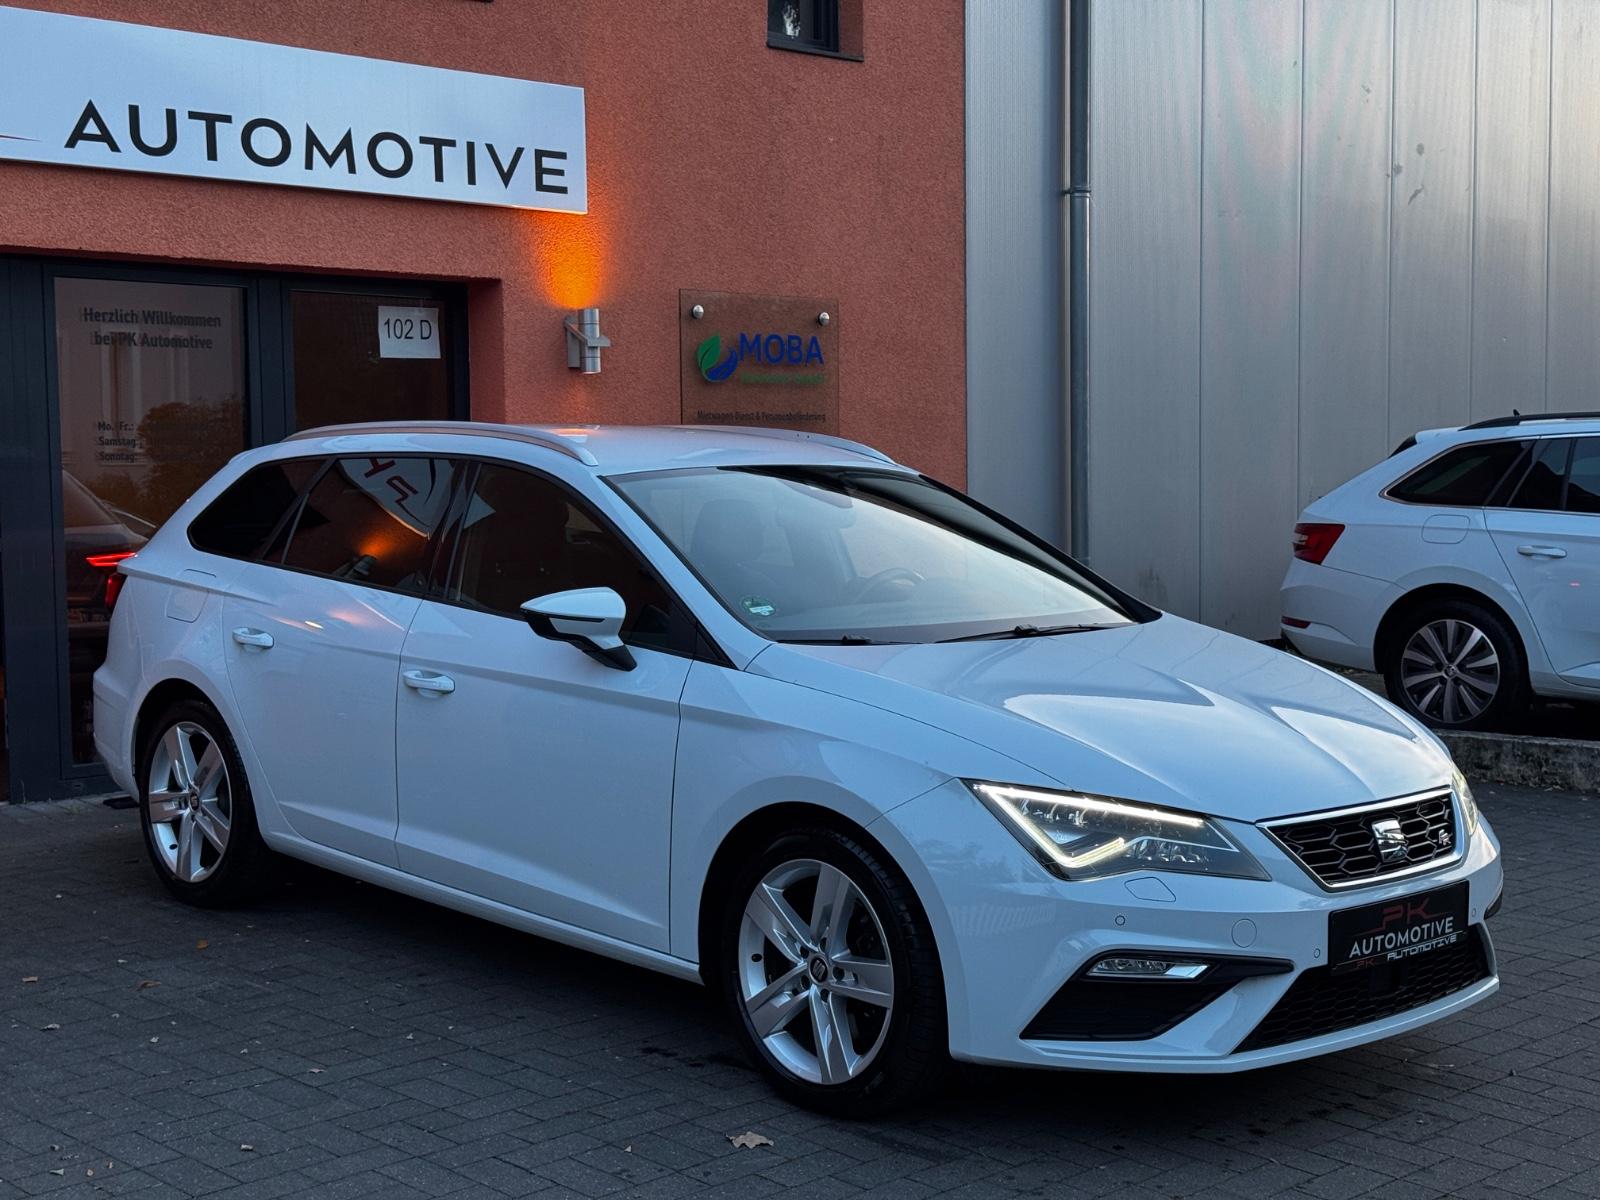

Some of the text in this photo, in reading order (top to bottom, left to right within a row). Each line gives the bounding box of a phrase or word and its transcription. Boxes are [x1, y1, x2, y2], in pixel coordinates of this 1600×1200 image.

[64, 99, 569, 195] AUTOMOTIVE
[83, 308, 221, 327] Herzlich Willkommen
[384, 317, 432, 340] 102 D
[94, 331, 213, 348] bei PK Automotive
[739, 333, 824, 366] MOBA
[1372, 897, 1436, 930] PK
[1348, 916, 1455, 959] AUTOMOTIVE
[1386, 934, 1458, 962] AUTOMOTIVE
